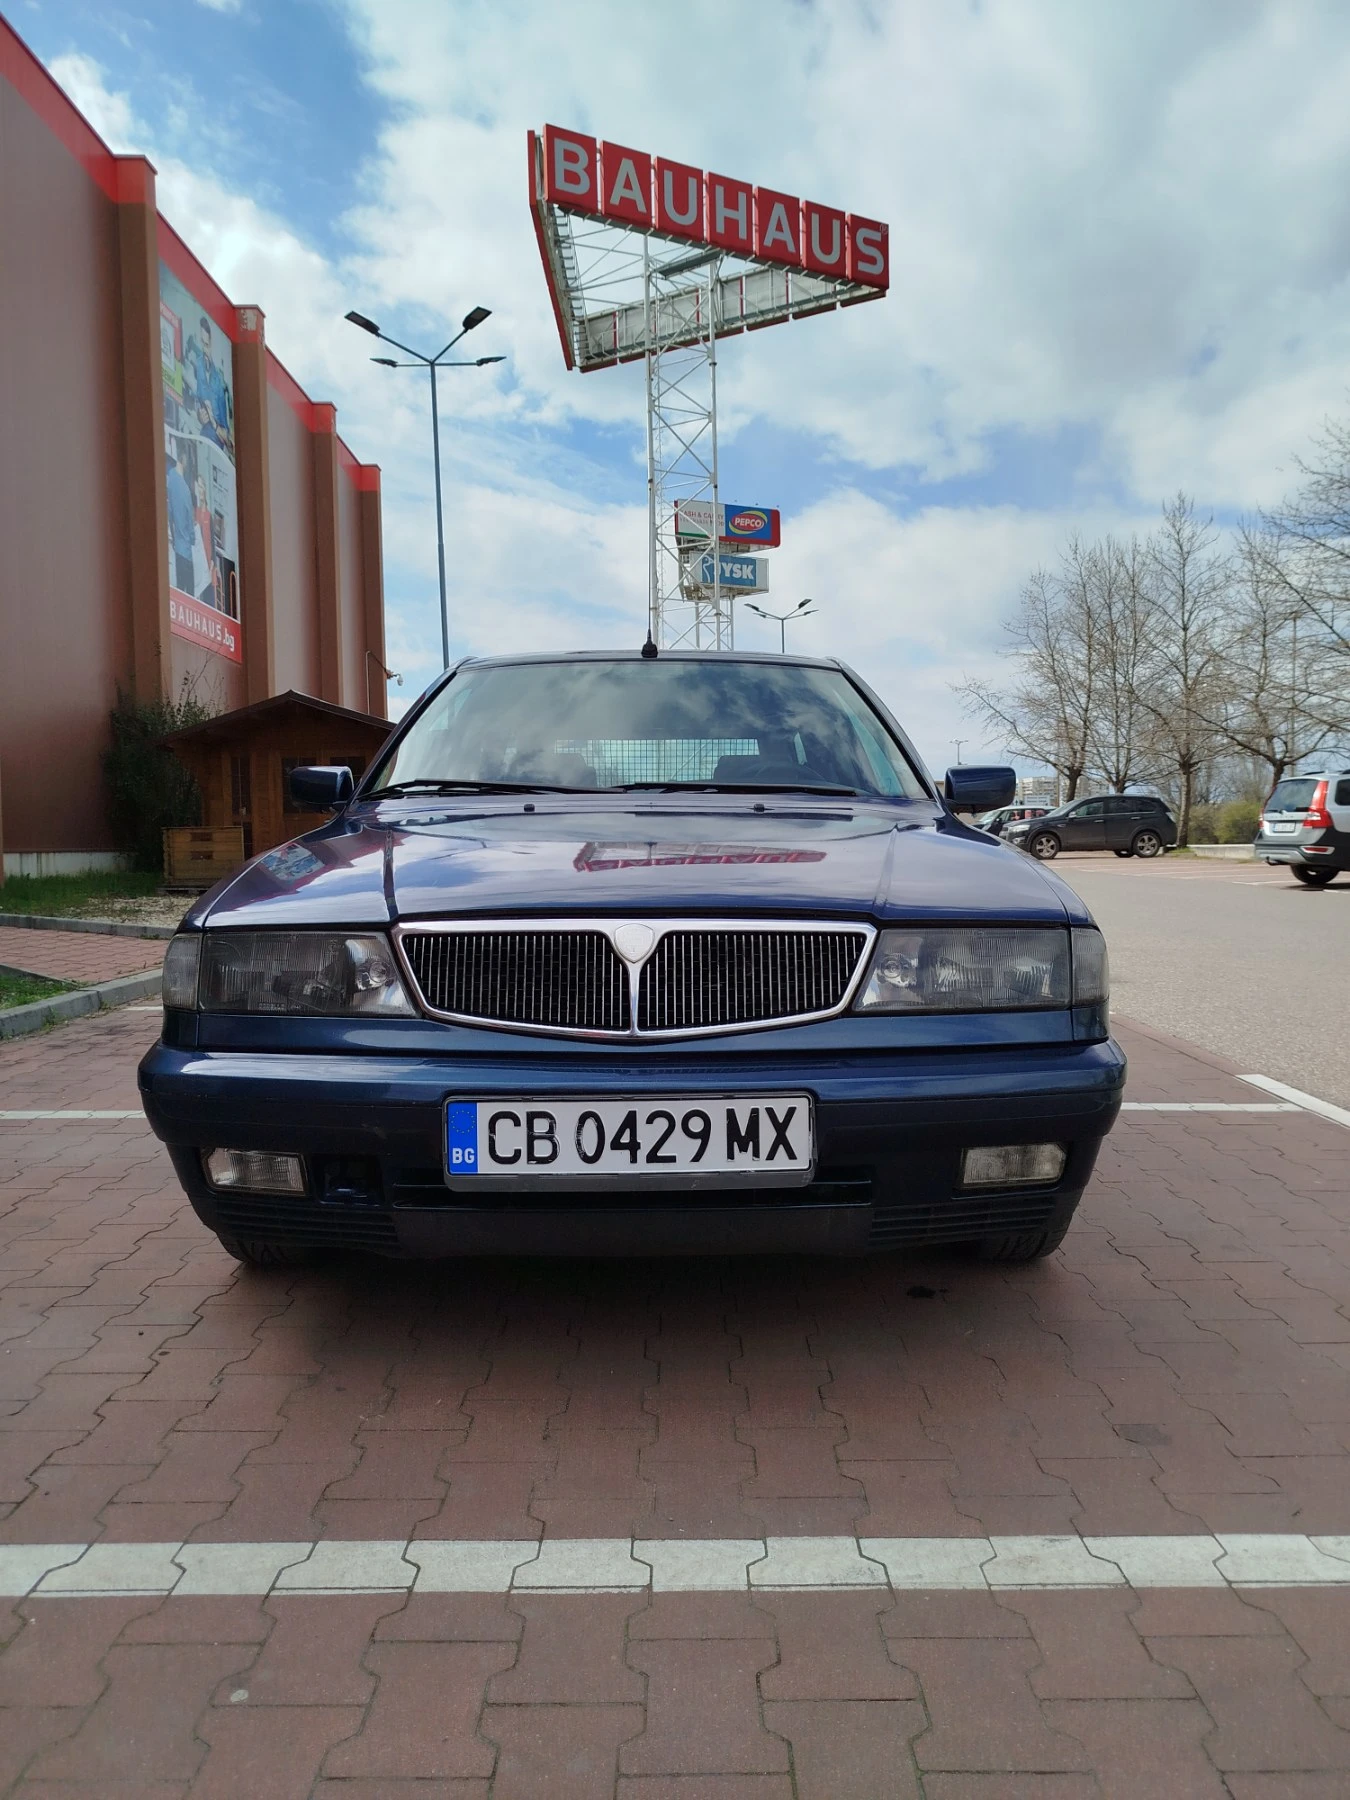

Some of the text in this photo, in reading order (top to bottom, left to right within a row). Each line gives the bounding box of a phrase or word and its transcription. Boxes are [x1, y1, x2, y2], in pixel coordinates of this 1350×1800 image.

[553, 138, 885, 275] BAUHAUS
[734, 517, 762, 528] PEPCO
[487, 1106, 798, 1165] CB 0429 MX
[452, 1147, 475, 1164] BG
